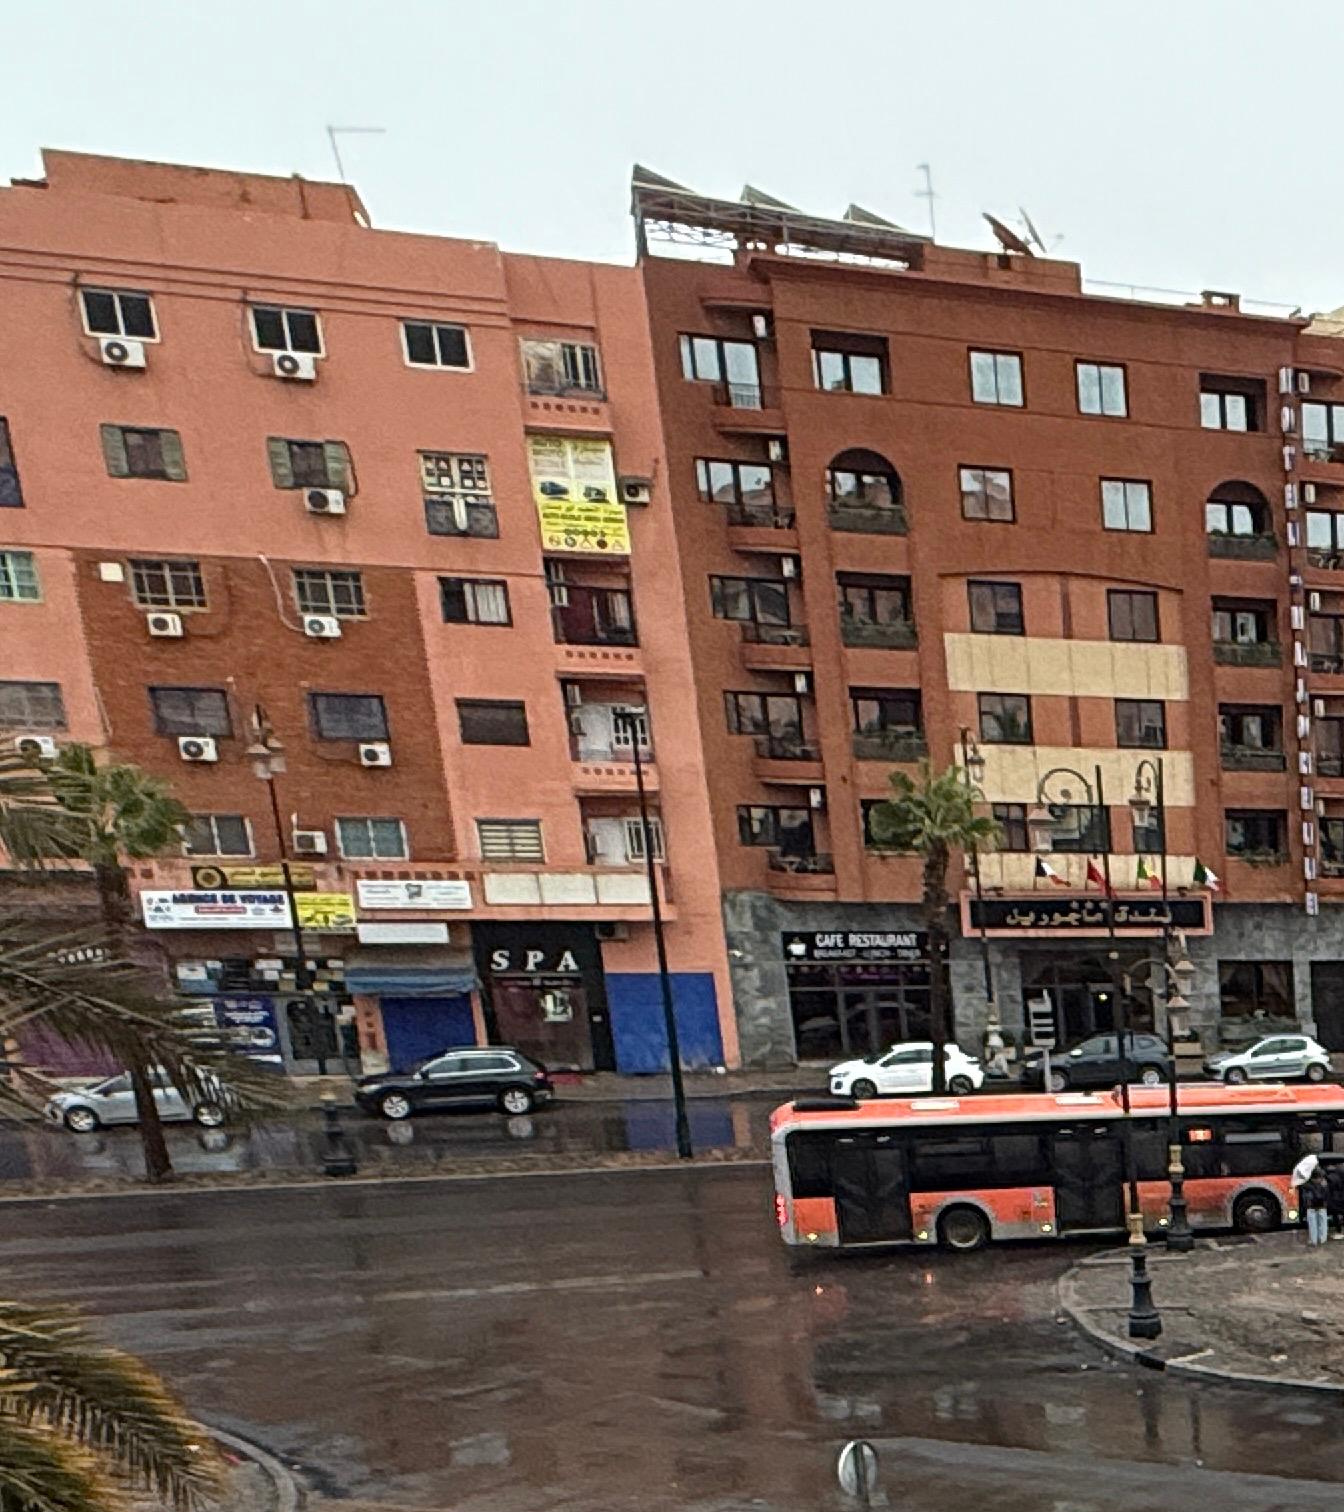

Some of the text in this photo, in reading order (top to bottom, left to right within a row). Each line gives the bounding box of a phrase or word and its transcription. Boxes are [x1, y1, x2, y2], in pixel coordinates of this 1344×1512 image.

[815, 933, 918, 948] CAFE RESTAURANT
[490, 949, 579, 972] SPA
